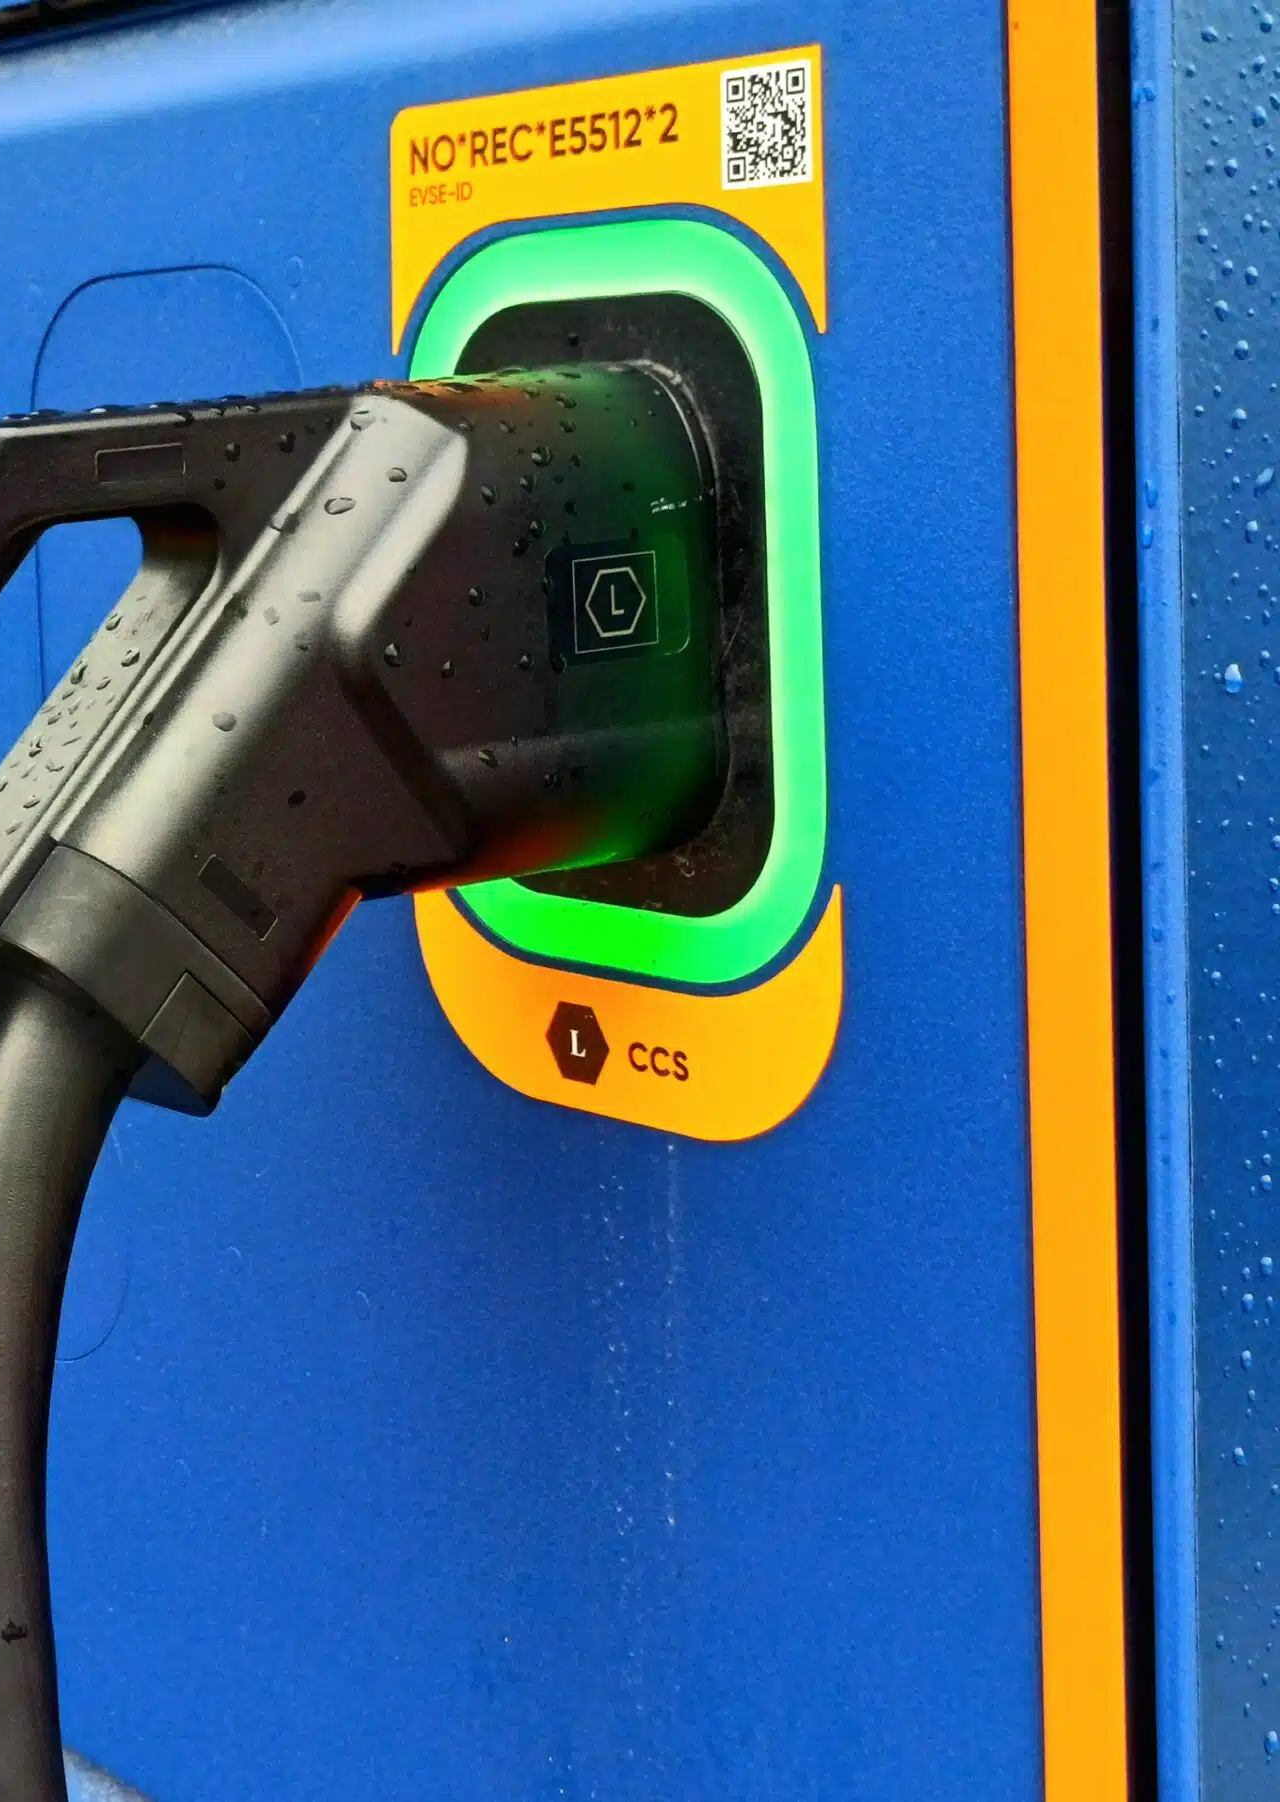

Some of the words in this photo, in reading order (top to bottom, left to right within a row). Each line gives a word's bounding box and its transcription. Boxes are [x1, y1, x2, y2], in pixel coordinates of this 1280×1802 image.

[408, 181, 473, 207] EVSE-ID
[610, 584, 624, 615] L
[569, 1029, 586, 1057] L
[628, 1042, 689, 1081] CCS
